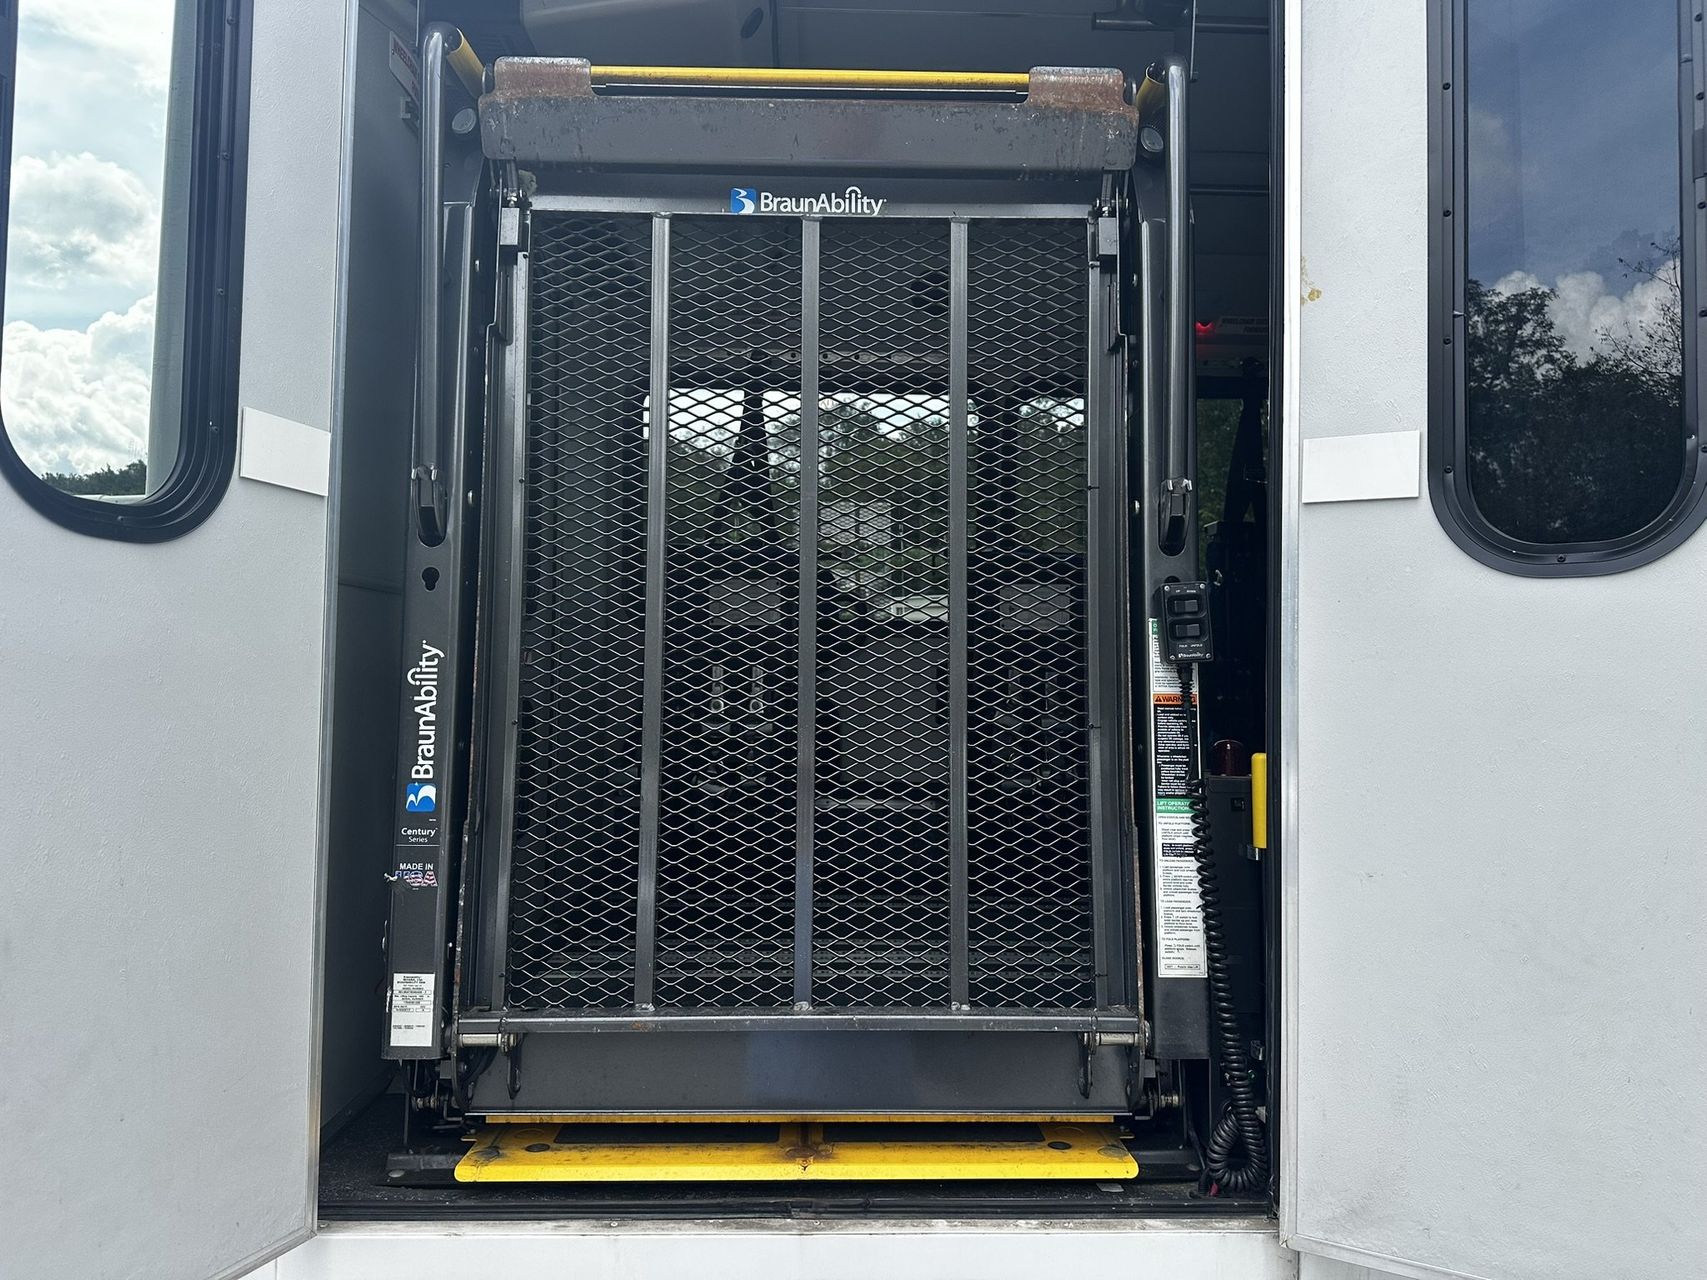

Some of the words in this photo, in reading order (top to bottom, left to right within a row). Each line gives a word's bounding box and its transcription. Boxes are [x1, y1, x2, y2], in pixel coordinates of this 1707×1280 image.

[760, 186, 883, 216] BraunAbility
[407, 644, 446, 779] BraunAbility
[401, 827, 436, 837] Century
